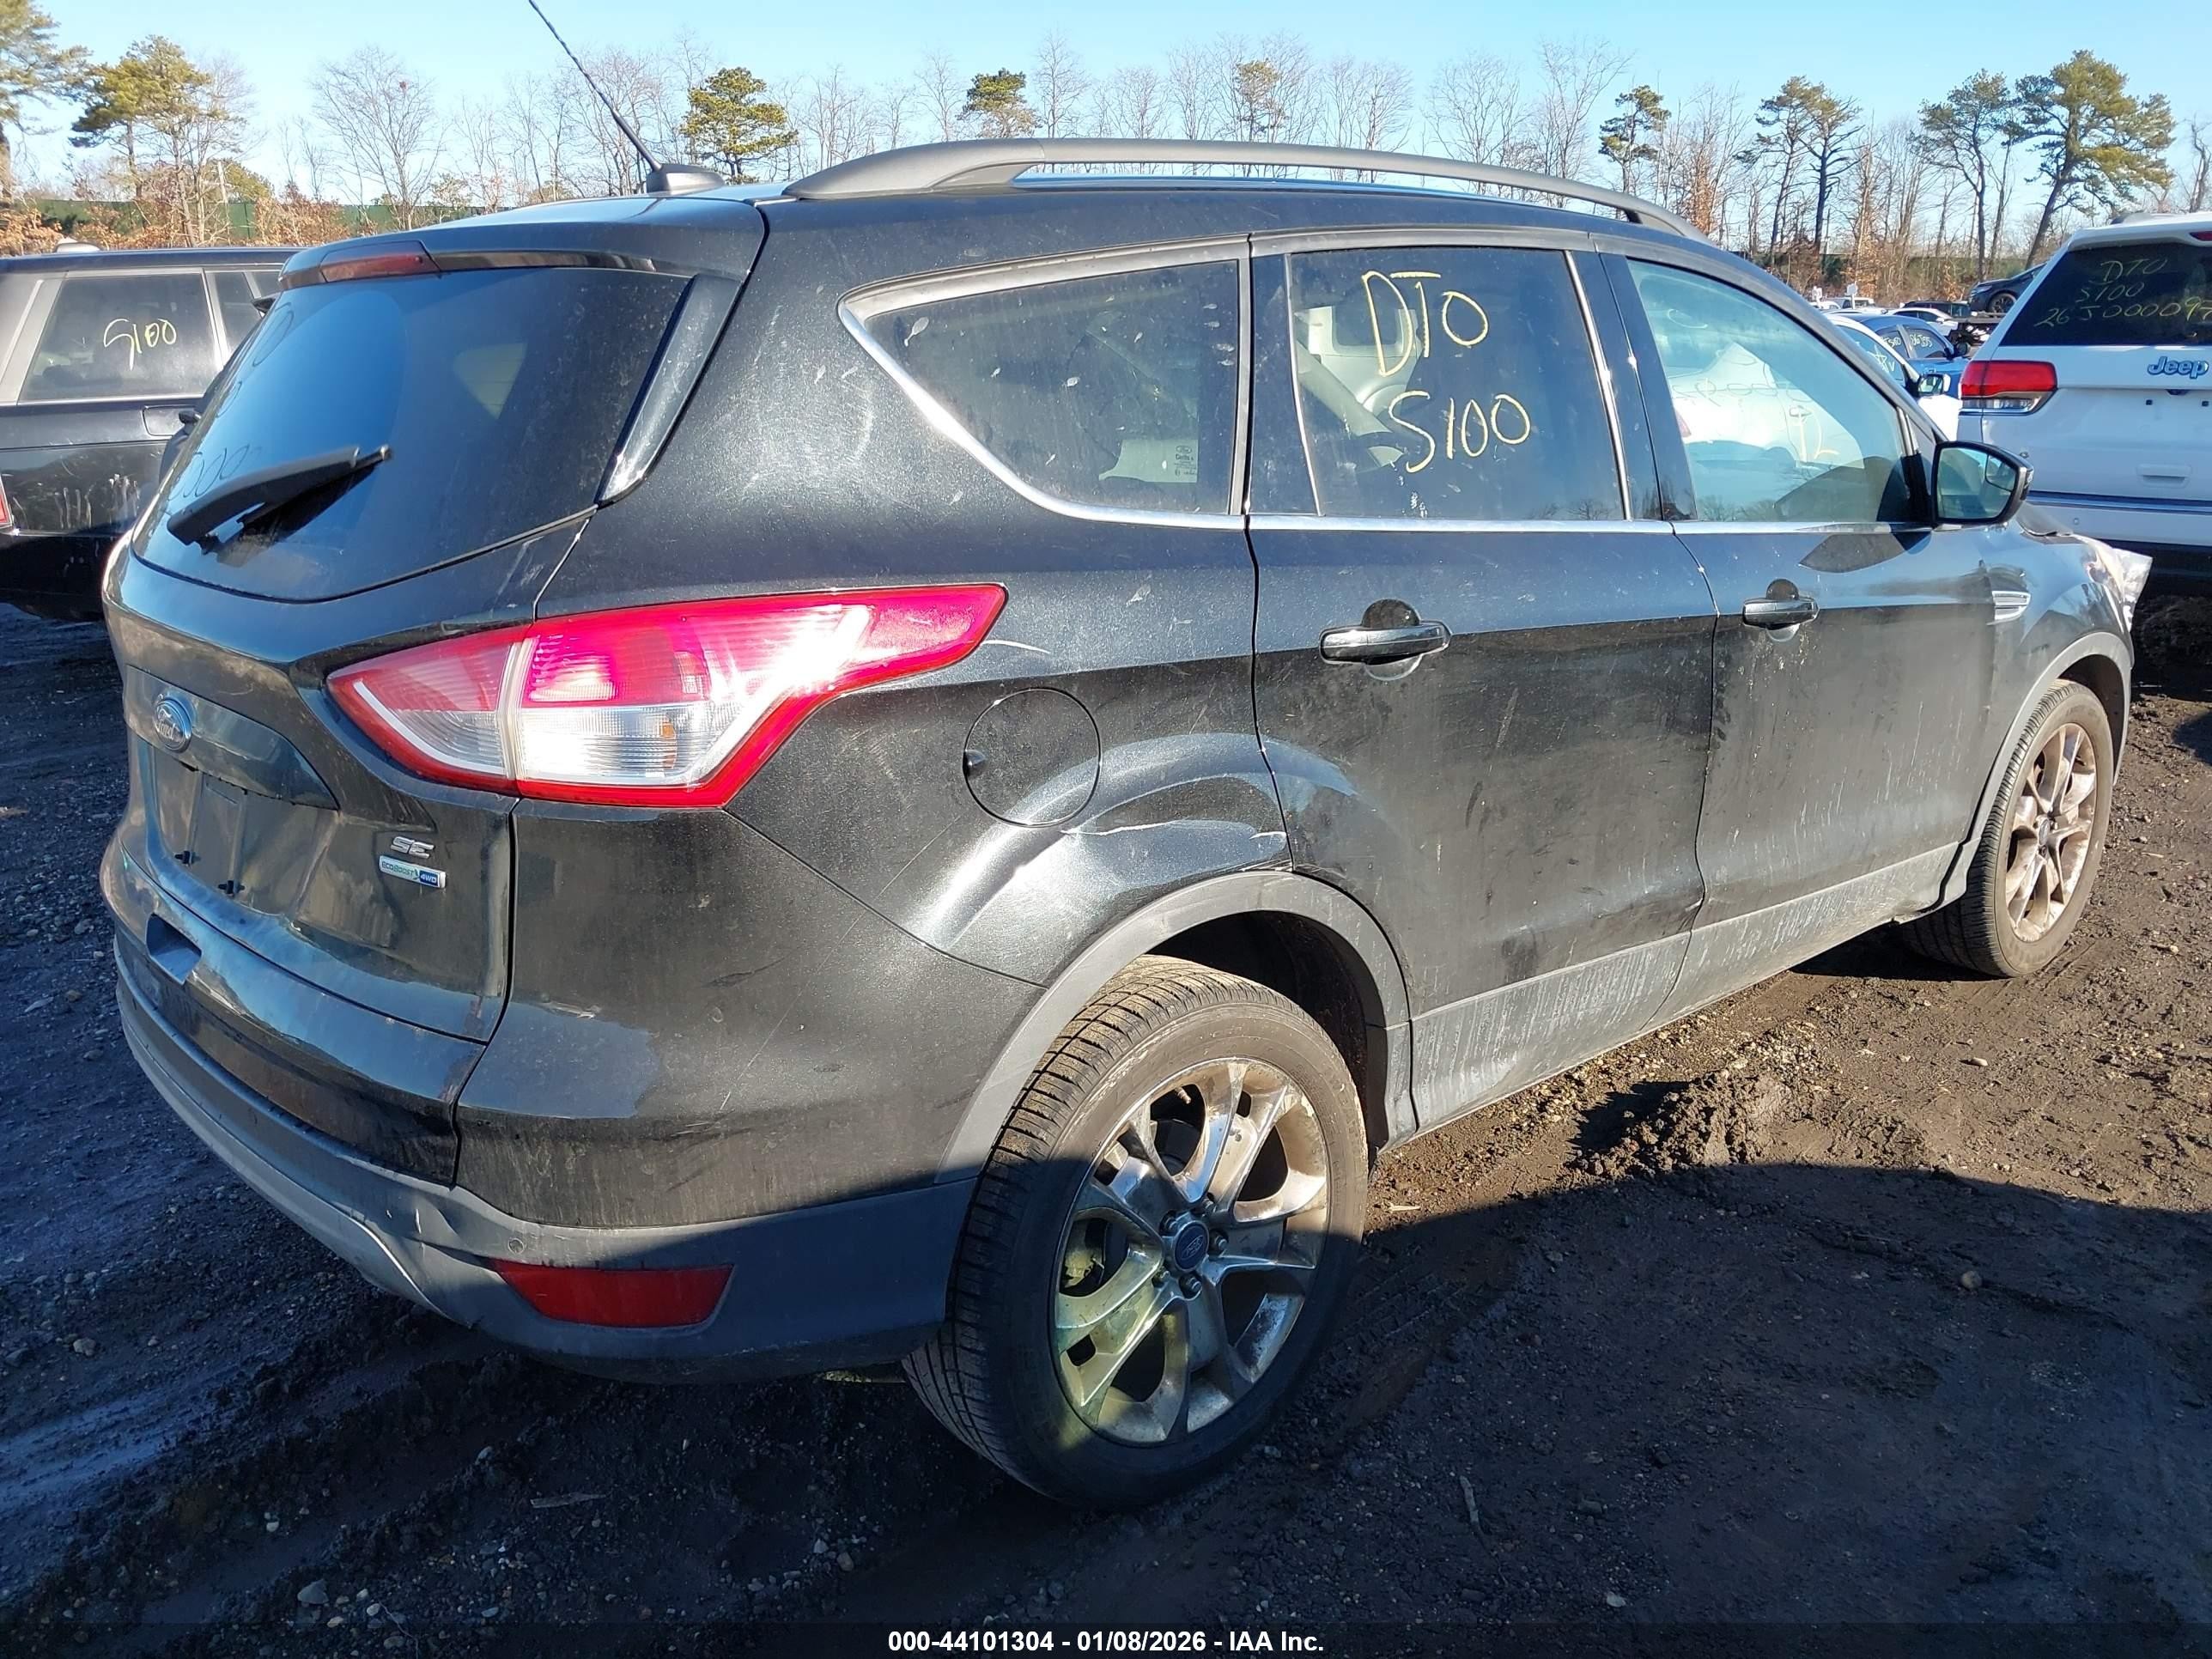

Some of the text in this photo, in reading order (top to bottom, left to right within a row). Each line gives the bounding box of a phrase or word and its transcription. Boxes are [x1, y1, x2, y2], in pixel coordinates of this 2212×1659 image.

[2089, 258, 2167, 284] DTO
[2076, 282, 2145, 302] S100
[1362, 270, 1490, 378] DTO
[2148, 356, 2209, 380] Jeep
[1388, 389, 1531, 473] S100
[390, 836, 434, 859] SE
[420, 872, 437, 884] 4WD
